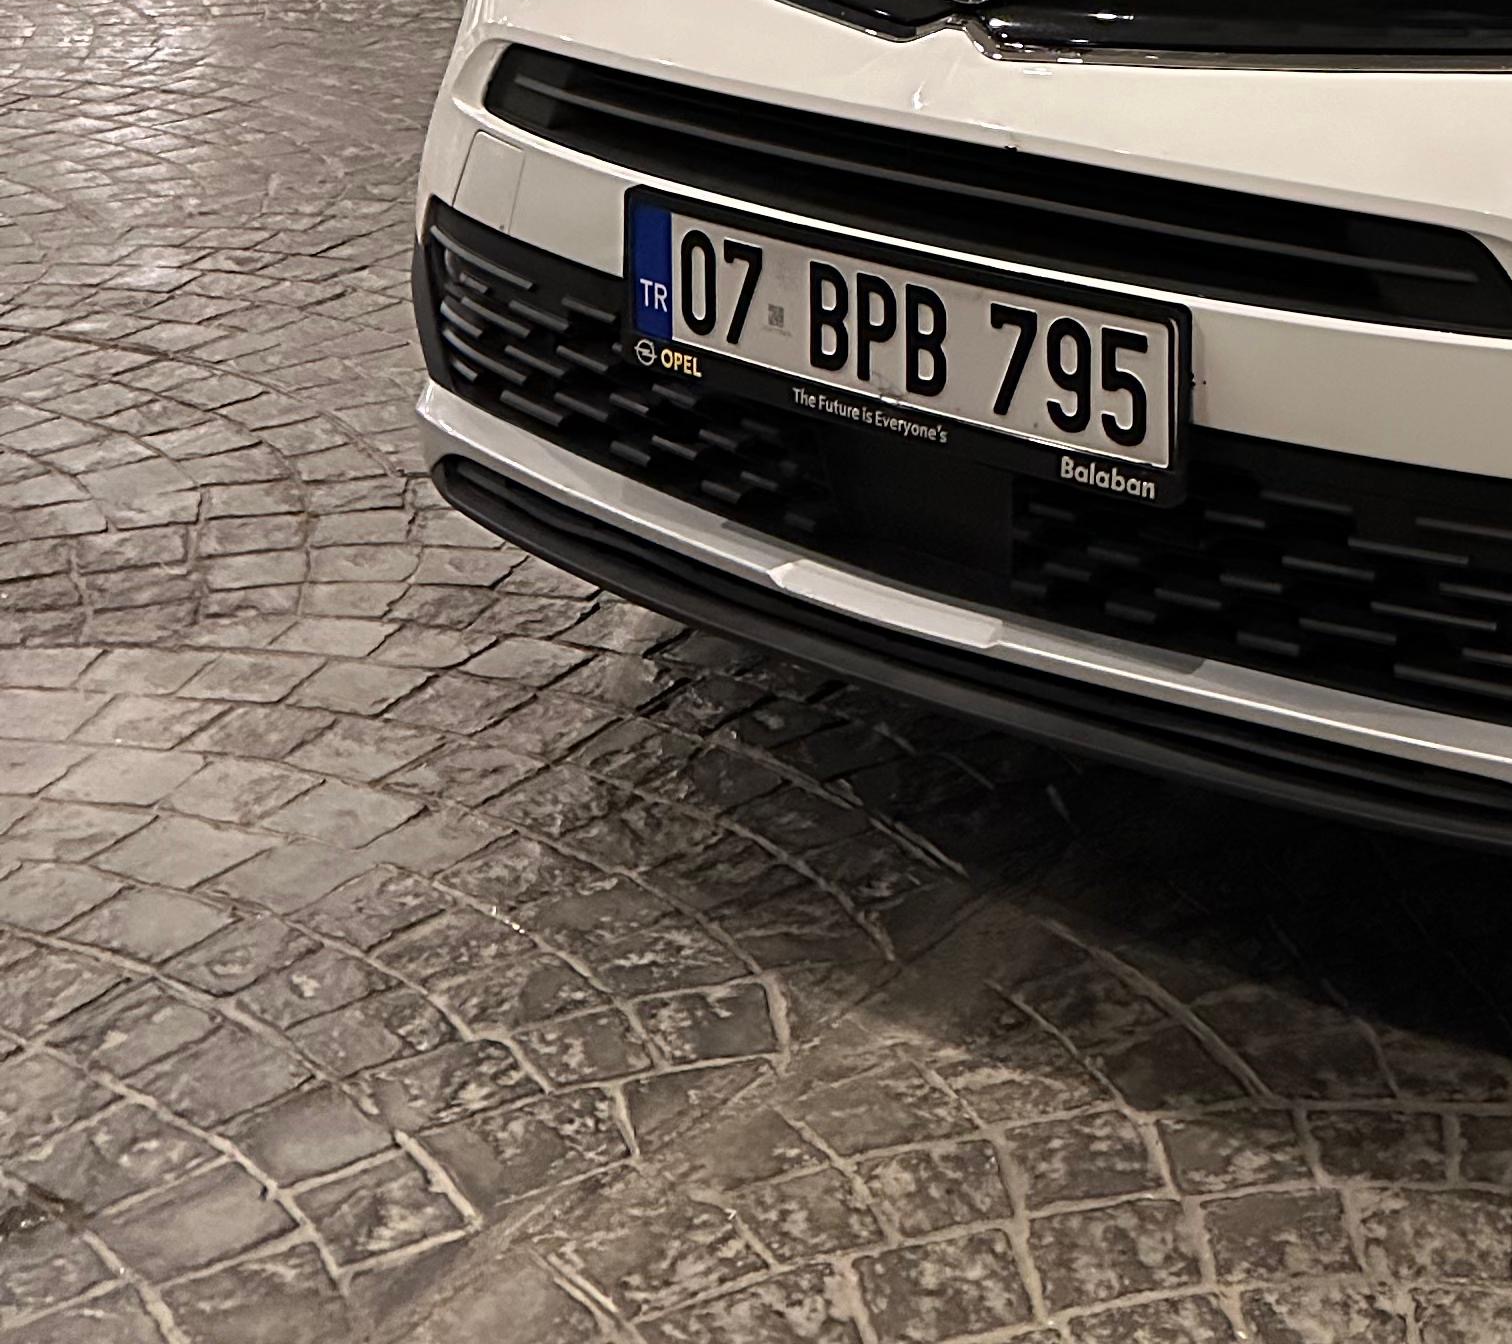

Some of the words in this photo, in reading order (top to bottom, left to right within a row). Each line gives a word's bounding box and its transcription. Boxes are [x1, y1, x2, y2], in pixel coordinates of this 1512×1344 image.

[639, 278, 668, 312] TR
[680, 229, 763, 345] 07
[809, 260, 948, 397] BPB
[990, 302, 1149, 447] 795
[660, 348, 702, 378] OPEL
[792, 387, 816, 408] The
[818, 395, 860, 421] Future
[862, 406, 873, 424] is
[875, 411, 948, 443] Everyone's
[1060, 455, 1156, 499] Balaban
